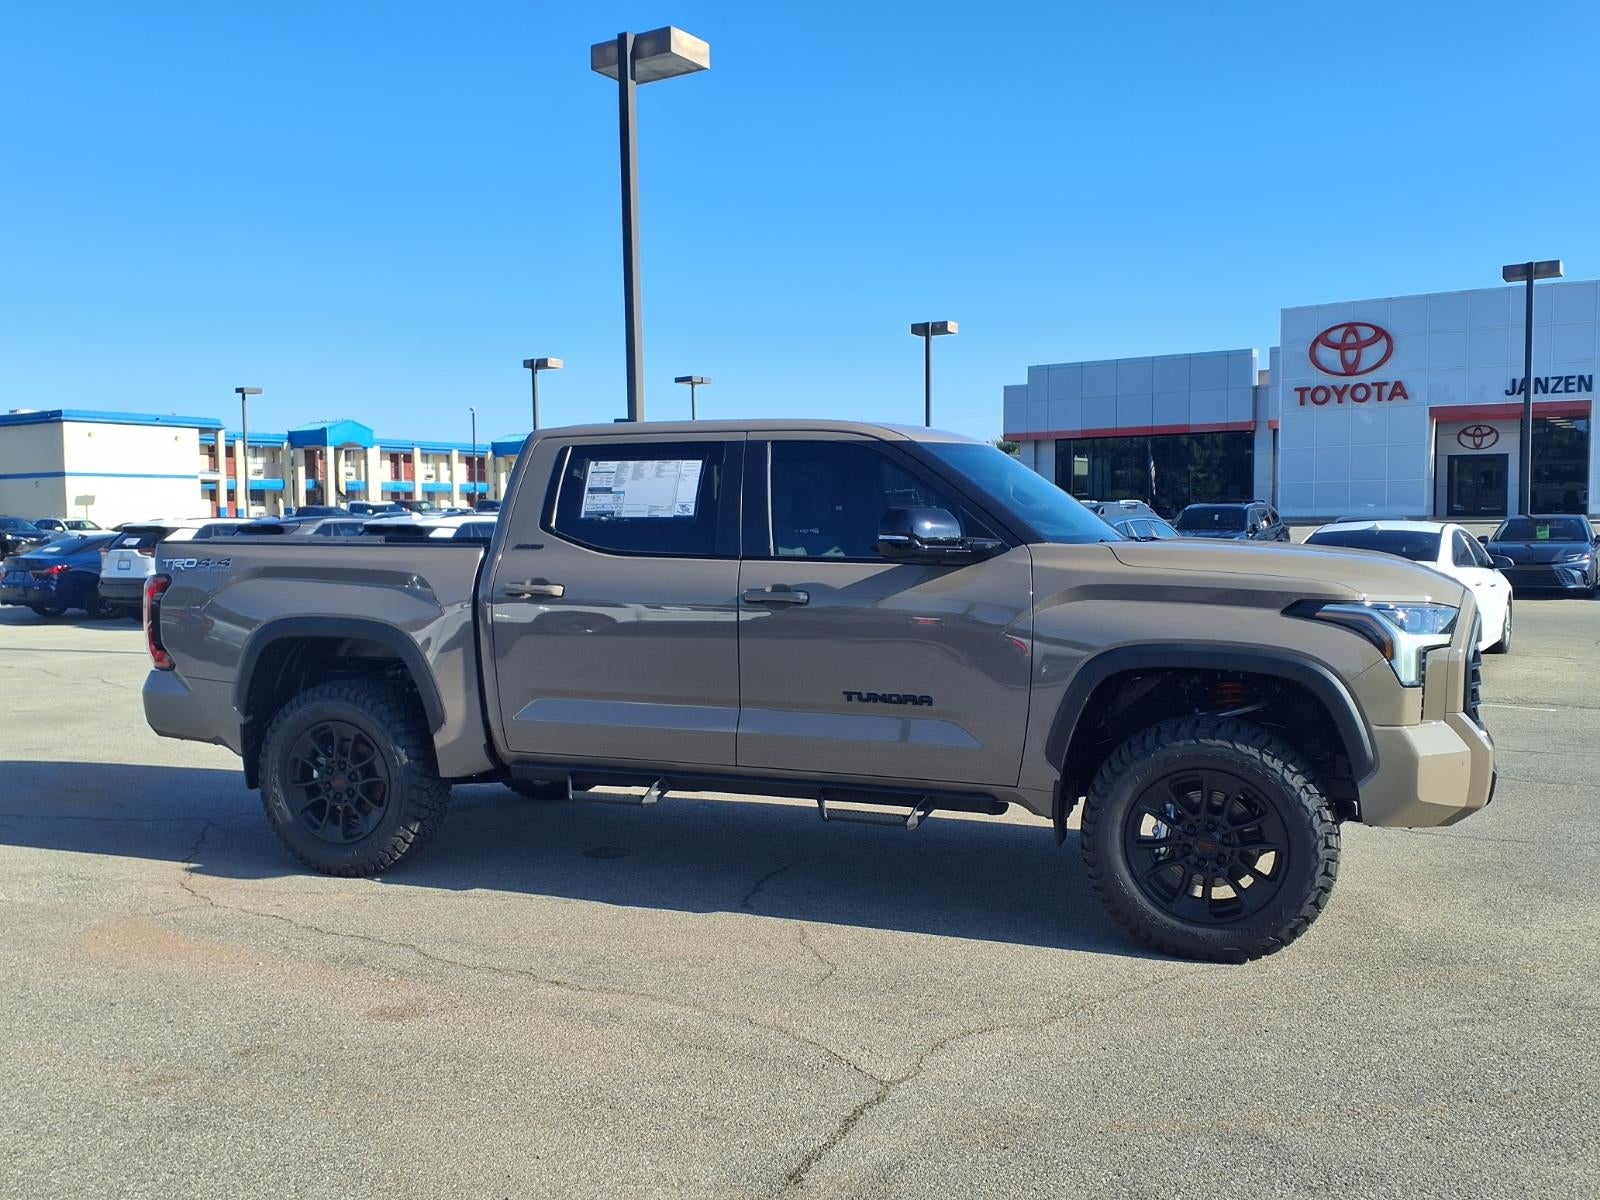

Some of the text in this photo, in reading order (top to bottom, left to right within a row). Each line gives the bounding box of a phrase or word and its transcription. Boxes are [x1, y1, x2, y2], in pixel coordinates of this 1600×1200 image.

[1294, 380, 1409, 406] TOYOTA
[163, 558, 198, 571] TRD
[842, 691, 933, 706] TUNDRA
